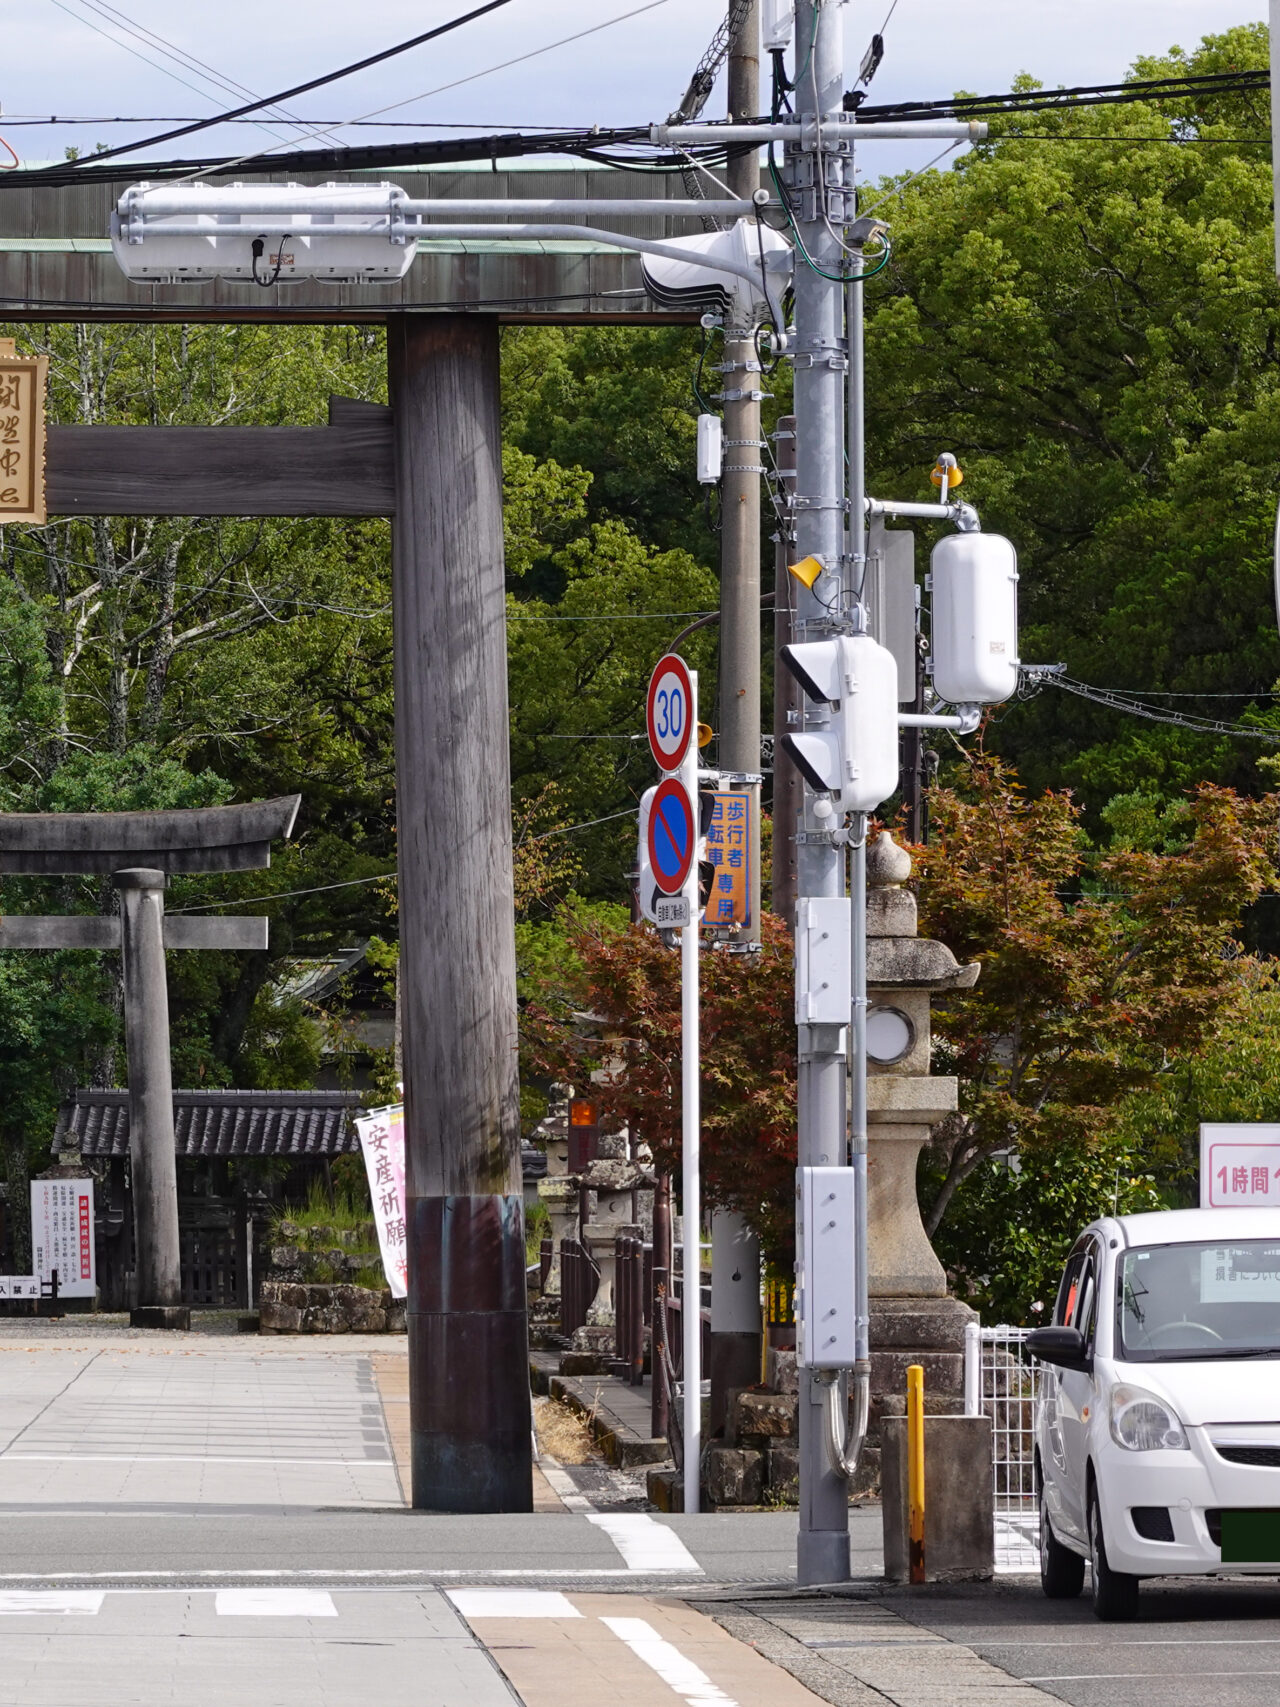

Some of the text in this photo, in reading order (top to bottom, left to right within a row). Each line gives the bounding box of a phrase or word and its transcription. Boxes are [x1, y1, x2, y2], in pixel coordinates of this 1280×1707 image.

[657, 688, 683, 739] 30
[707, 802, 724, 868] 自転車
[727, 801, 745, 868] 歩行者
[717, 873, 734, 919] 専用
[367, 1124, 407, 1246] 安産祈願
